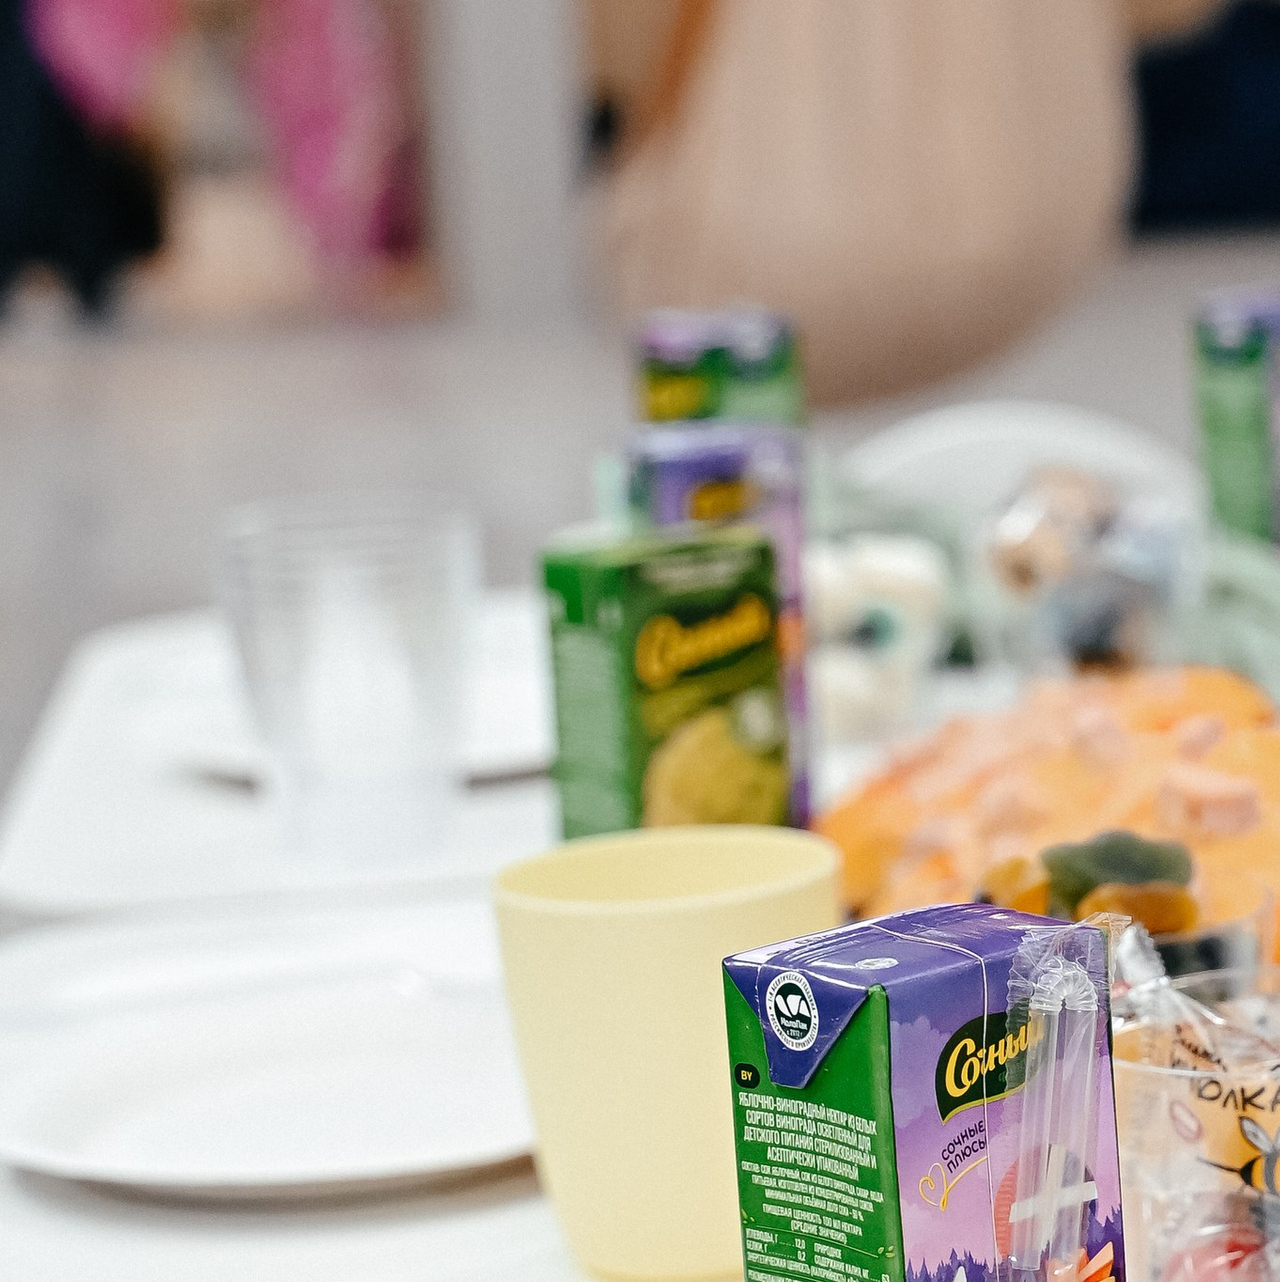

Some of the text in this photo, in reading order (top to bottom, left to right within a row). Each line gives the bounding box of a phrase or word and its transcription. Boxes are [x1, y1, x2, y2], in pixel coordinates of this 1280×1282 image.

[740, 1070, 753, 1081] BY
[738, 1091, 877, 1135] ЯБЛОЧНО-ВИНОГРАДНЫЙ НЕКТАР ИЗ БЕЛЫХ
[746, 1109, 871, 1151] СОРТОВ ВИНОГРАДА ОСВЕТЛЕННЫЙ ДЛЯ
[743, 1125, 876, 1169] ДЕТСКОГО ПИТАНИЯ СТЕРИЛИЗОВАННЫЙ И
[941, 1120, 986, 1161] СОЧНЫЕ
[767, 1146, 815, 1168] АСЕПТИЧЕСКИ
[815, 1155, 858, 1181] УПАКОВАННЫЙ
